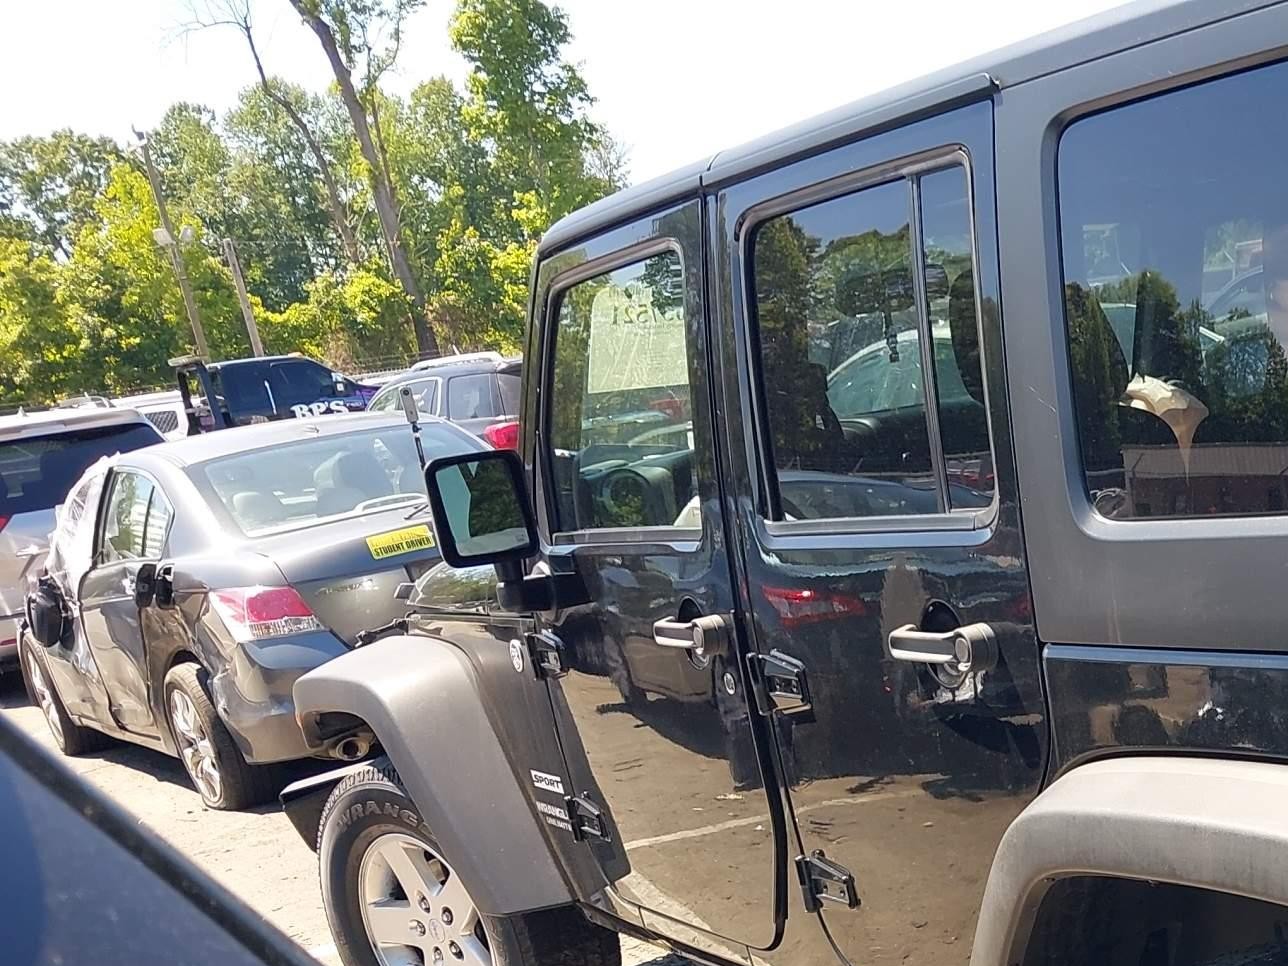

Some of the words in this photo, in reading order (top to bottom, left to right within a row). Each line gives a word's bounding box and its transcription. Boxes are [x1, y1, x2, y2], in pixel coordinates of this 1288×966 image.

[290, 400, 349, 420] BP'S
[374, 543, 405, 557] STUDENT
[406, 536, 432, 550] DRIVER
[533, 774, 563, 790] SPORT
[536, 801, 569, 820] WRANGL
